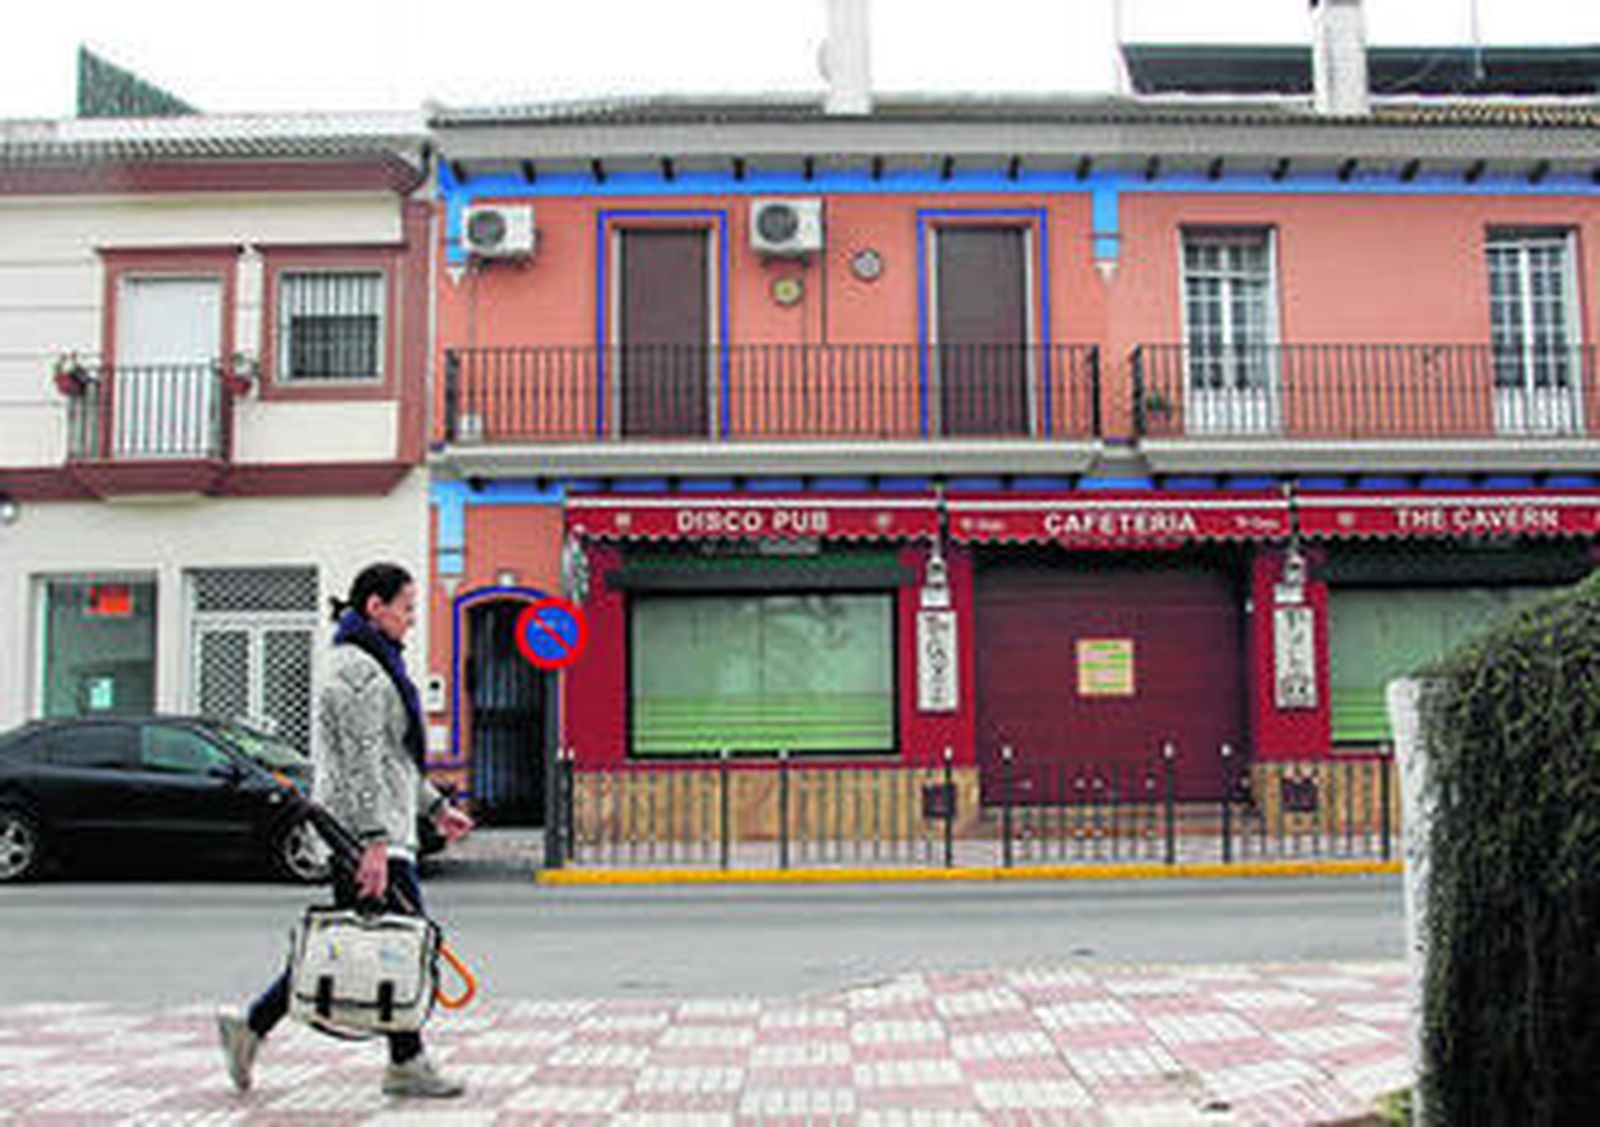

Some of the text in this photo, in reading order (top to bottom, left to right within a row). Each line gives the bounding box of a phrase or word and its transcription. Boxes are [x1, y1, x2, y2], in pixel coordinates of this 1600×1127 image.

[677, 510, 828, 531] DISCO PUB
[1043, 510, 1197, 533] CAFETERIA
[1397, 507, 1559, 528] THE CAVERN
